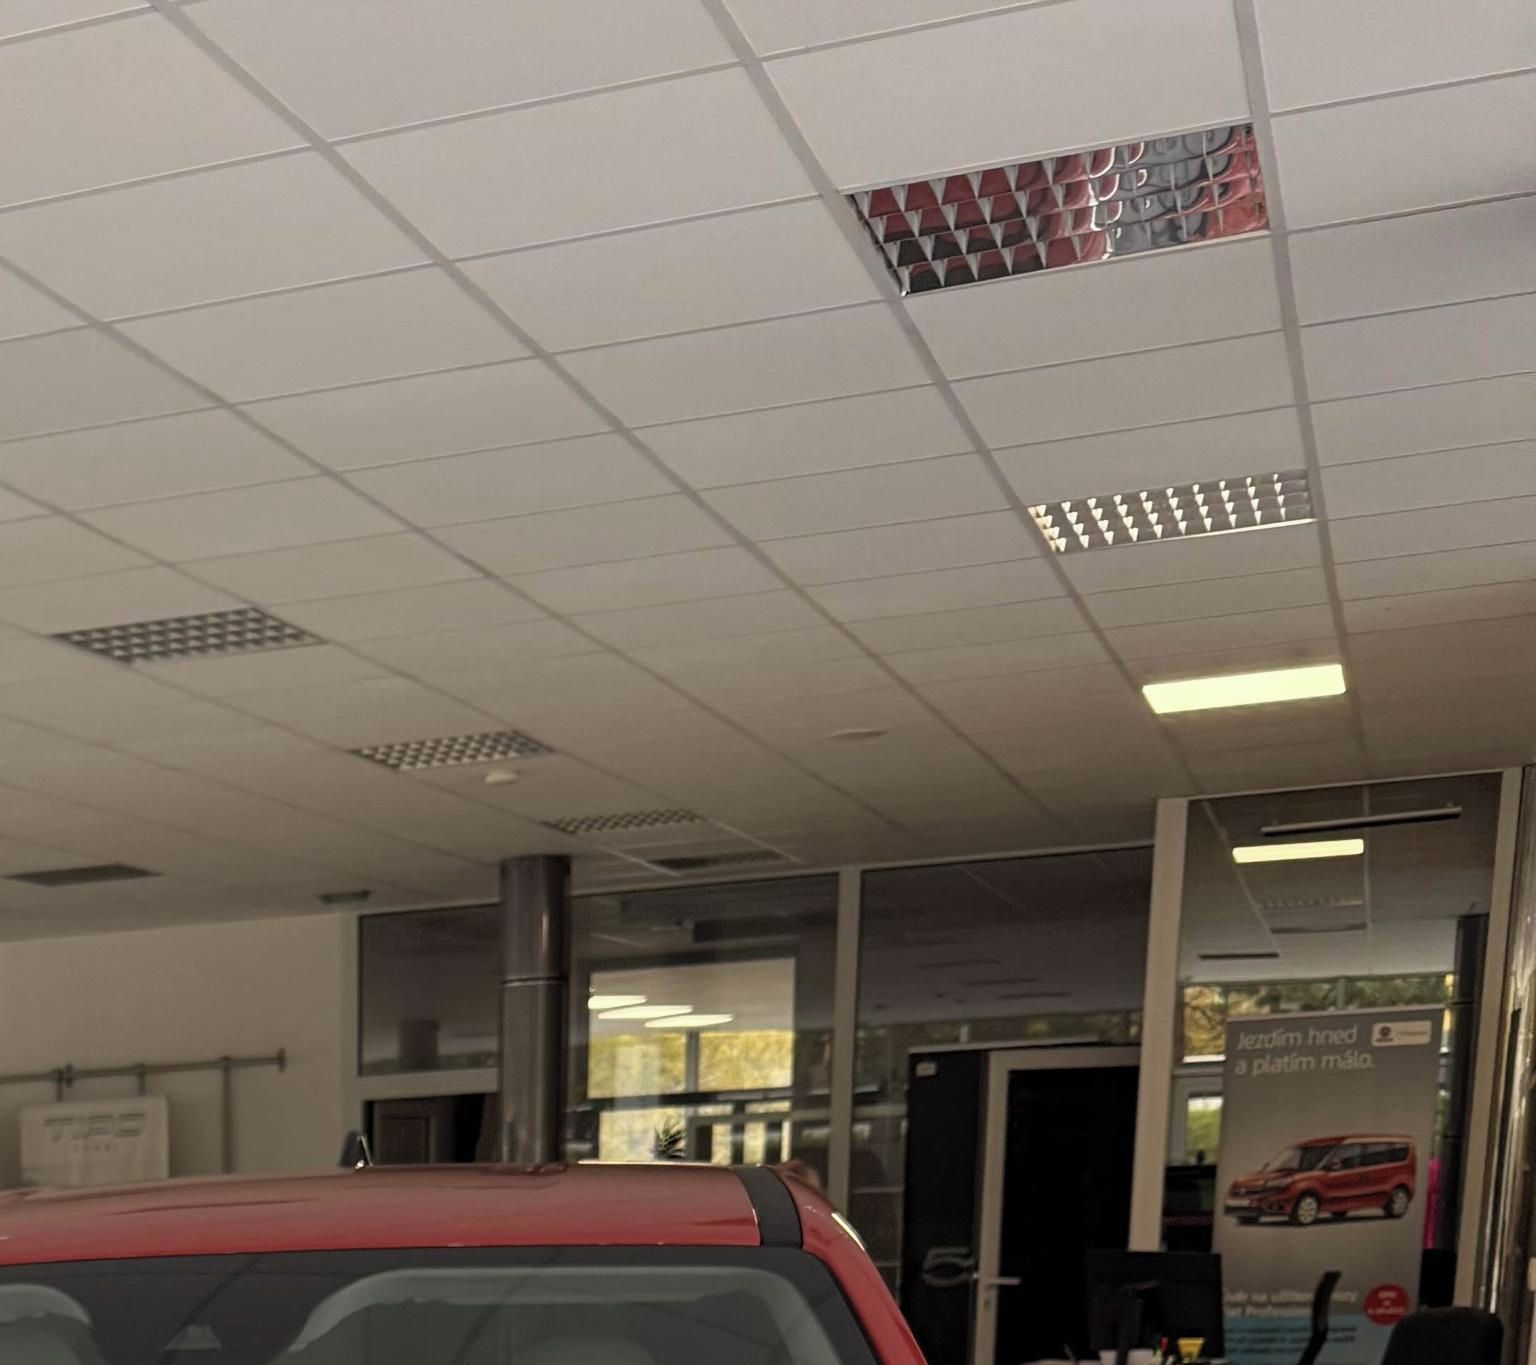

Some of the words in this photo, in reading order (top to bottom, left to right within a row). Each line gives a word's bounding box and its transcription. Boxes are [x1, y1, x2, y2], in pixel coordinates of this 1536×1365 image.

[1237, 1028, 1302, 1050] Jezdím
[1308, 1026, 1358, 1046] hned
[1235, 1061, 1247, 1075] a
[1252, 1052, 1314, 1076] platím
[1321, 1050, 1376, 1070] málo.
